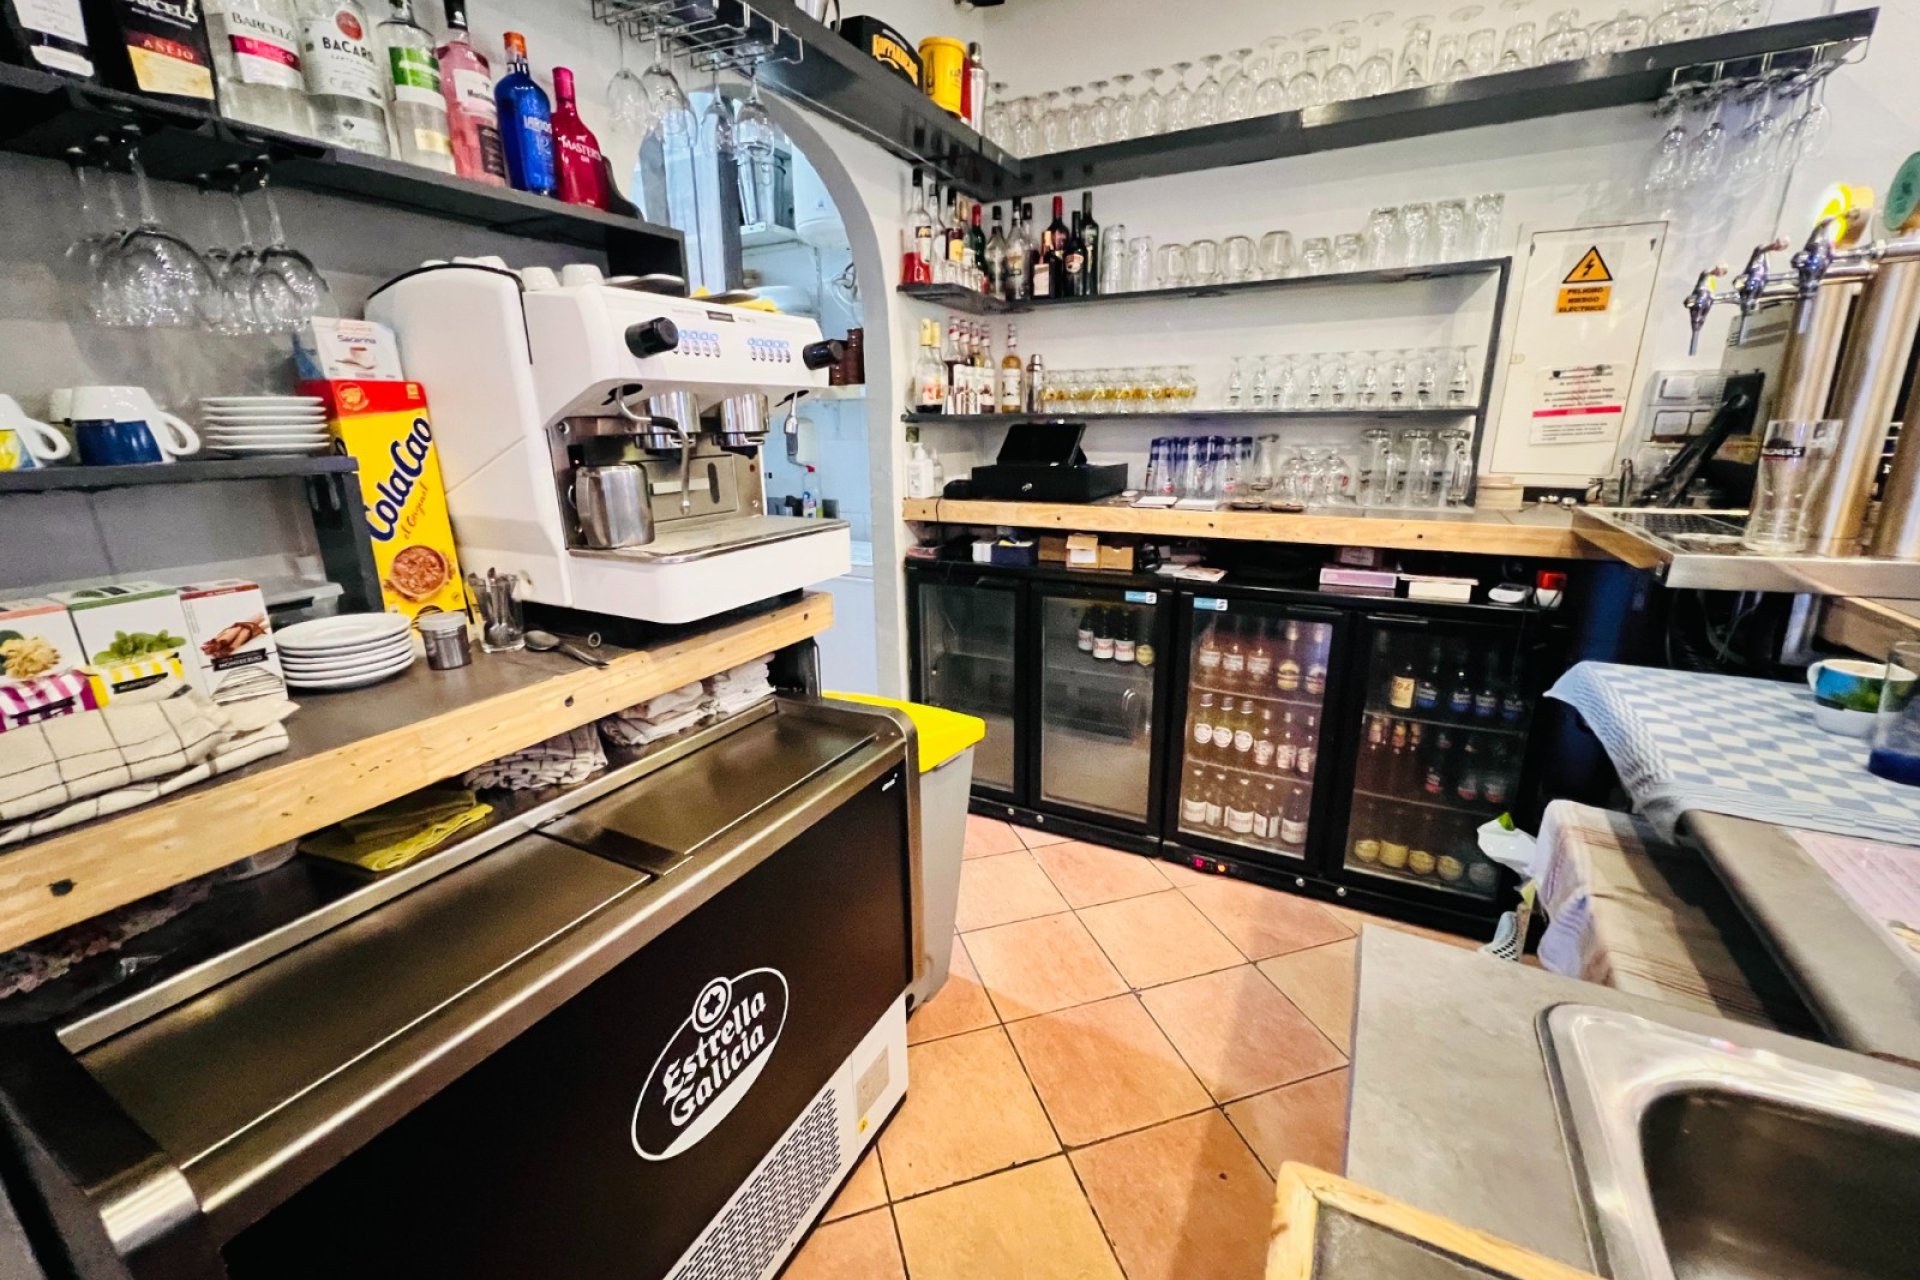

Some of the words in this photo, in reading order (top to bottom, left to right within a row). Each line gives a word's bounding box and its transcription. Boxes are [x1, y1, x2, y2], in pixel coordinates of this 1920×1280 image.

[143, 38, 194, 61] AÑEJO
[1567, 286, 1604, 294] PELIGRO
[366, 417, 432, 542] ColaCao
[662, 991, 767, 1106] Estrella
[670, 1023, 766, 1127] Galicia
